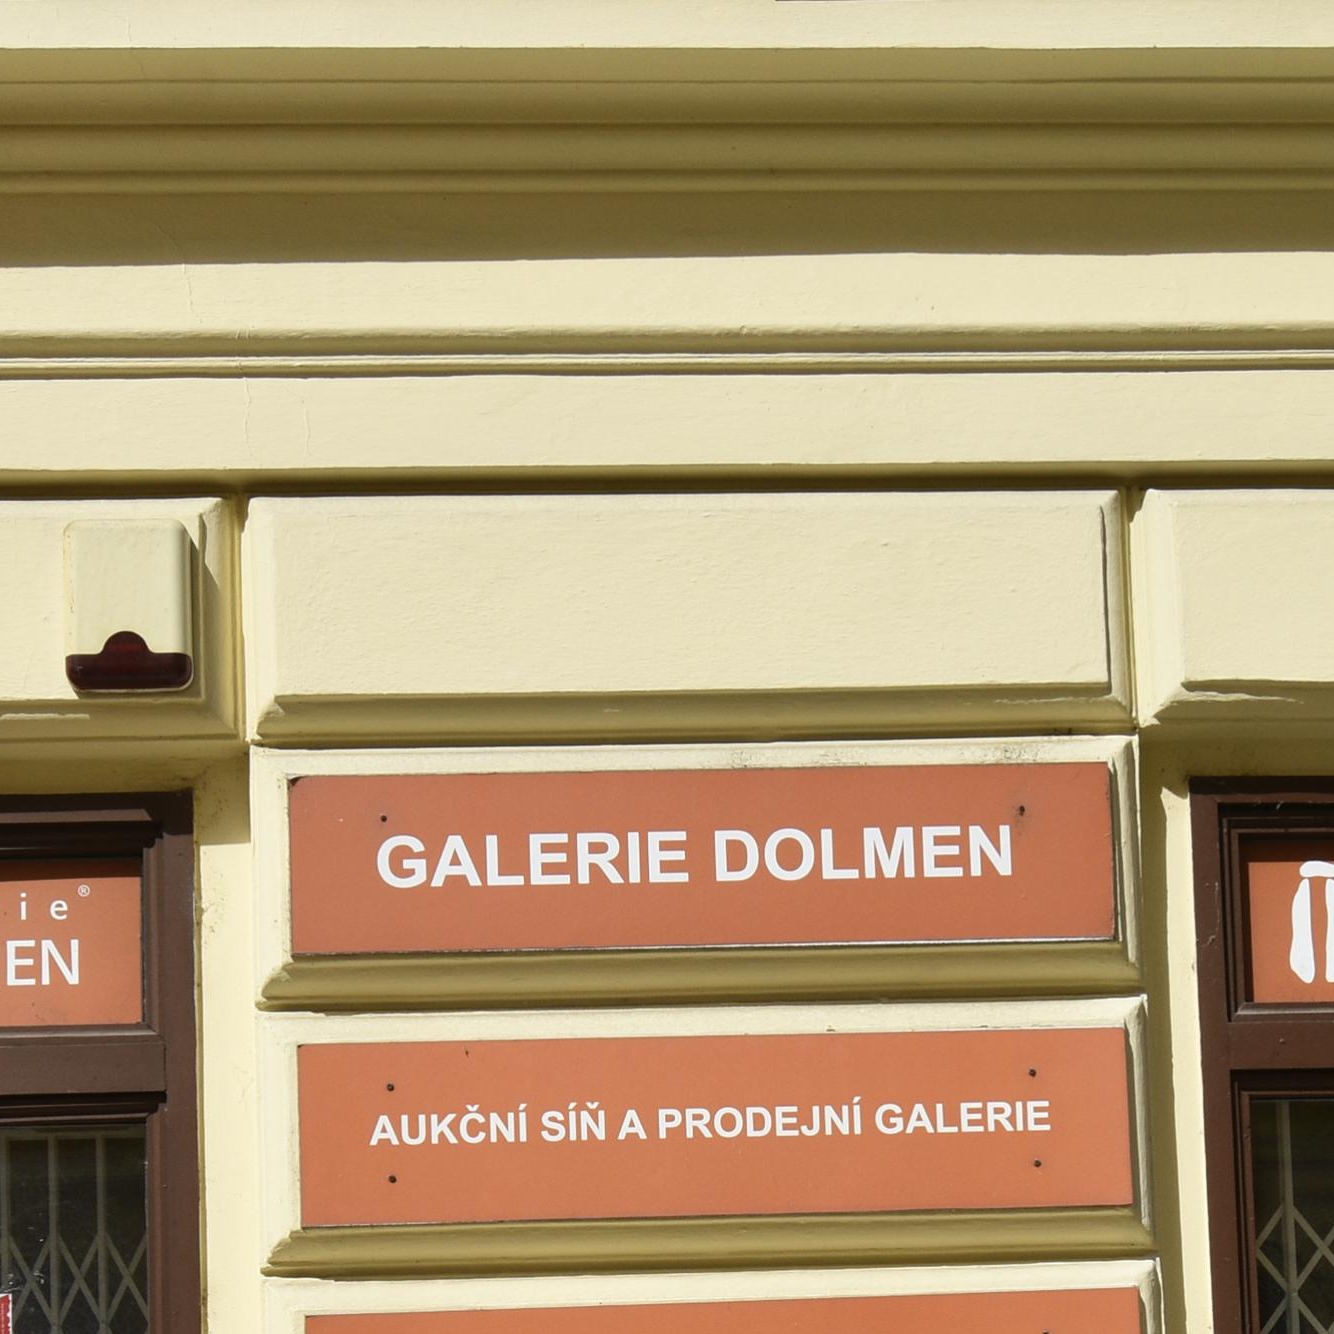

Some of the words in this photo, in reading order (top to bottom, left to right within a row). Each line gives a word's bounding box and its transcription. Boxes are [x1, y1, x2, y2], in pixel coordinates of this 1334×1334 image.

[377, 831, 688, 888] GALERIE
[715, 825, 1013, 881] DOLMEN
[369, 1103, 528, 1146] AUKČNÍ
[540, 1101, 606, 1142] SÍŇ
[617, 1109, 647, 1140] A
[658, 1096, 862, 1139] PRODEJNÍ
[874, 1100, 1051, 1135] GALERIE
